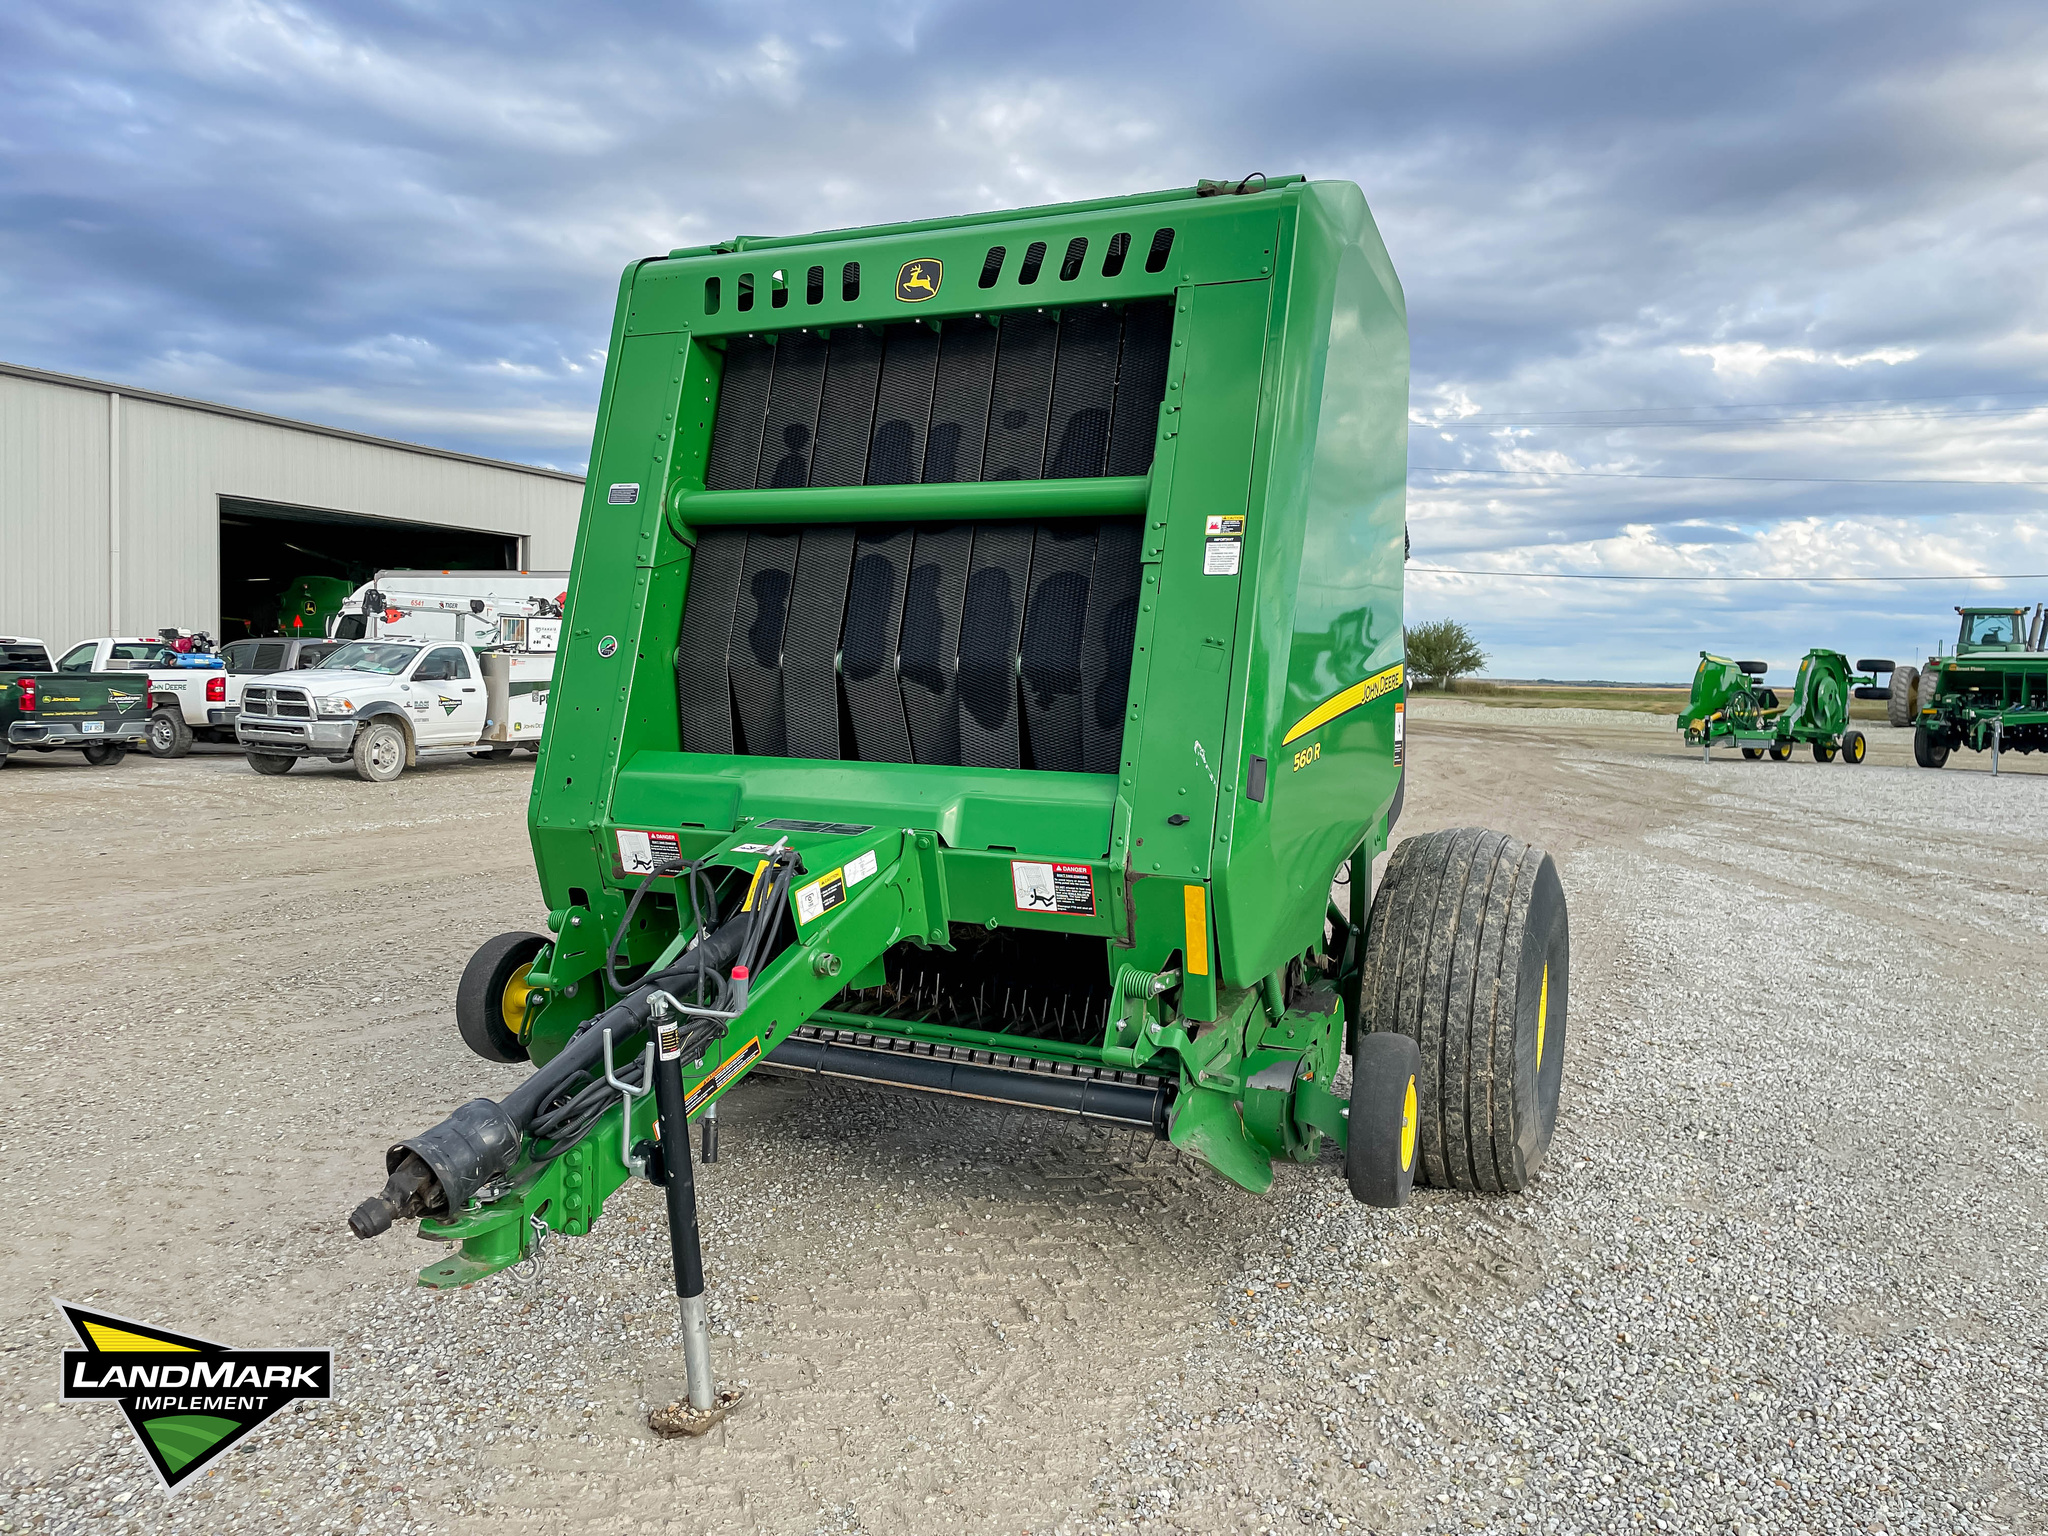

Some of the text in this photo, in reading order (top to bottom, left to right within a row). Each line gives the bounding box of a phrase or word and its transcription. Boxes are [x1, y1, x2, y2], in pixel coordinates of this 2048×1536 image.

[411, 599, 425, 607] 6541
[165, 683, 187, 691] DEERE
[1362, 672, 1400, 704] JOHN DEERE
[1293, 742, 1321, 773] 560 R
[1062, 865, 1087, 873] DANGER
